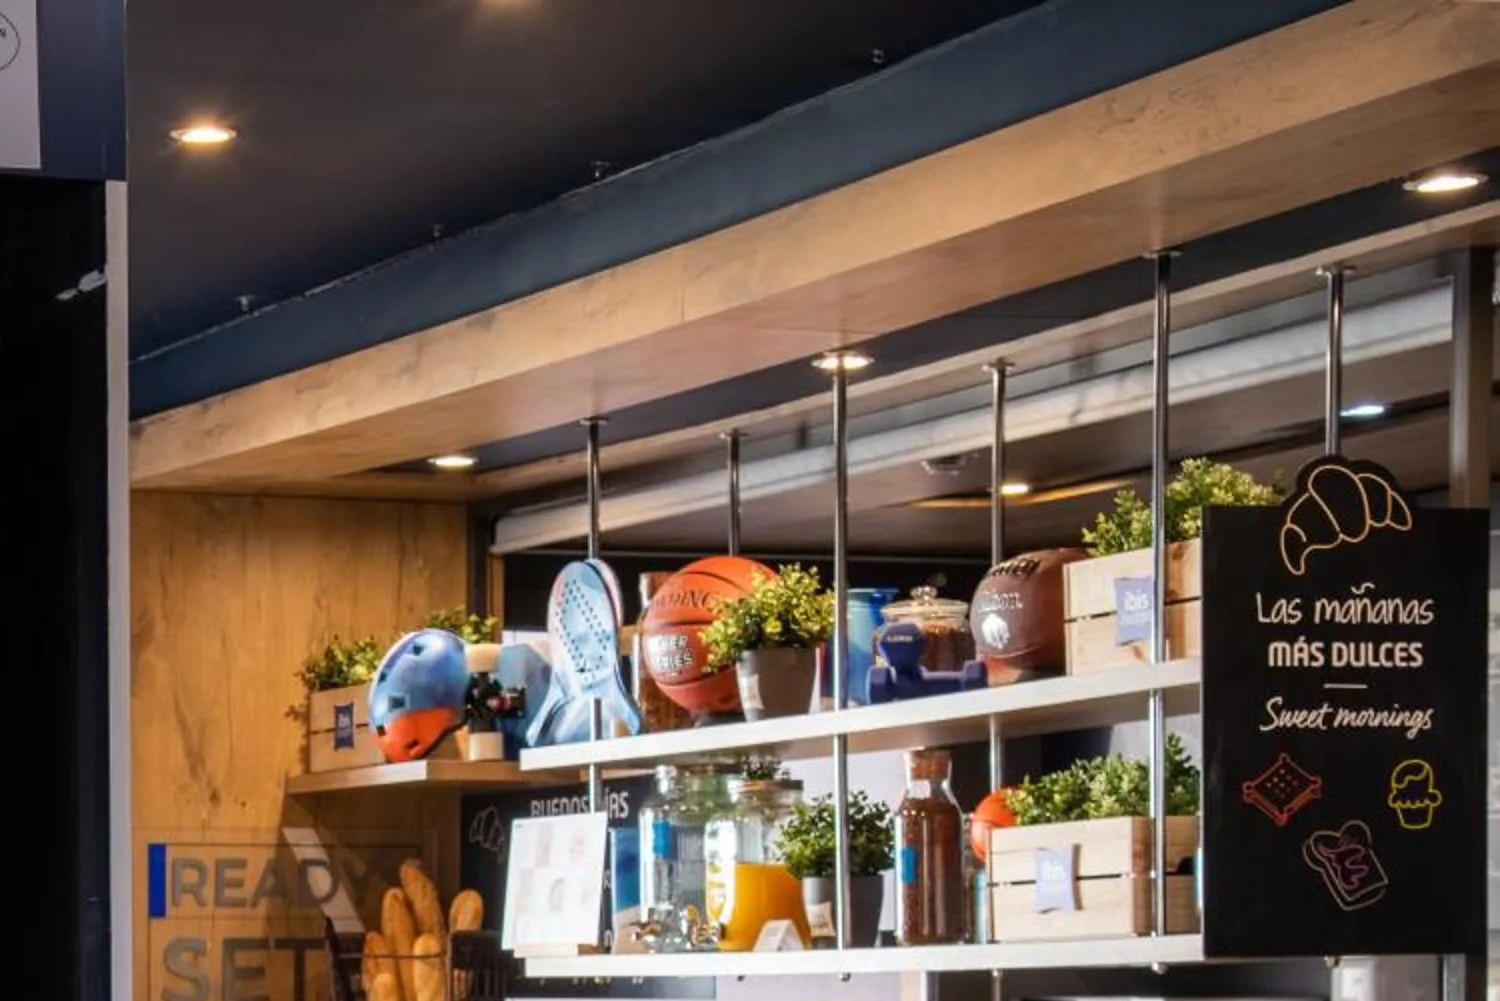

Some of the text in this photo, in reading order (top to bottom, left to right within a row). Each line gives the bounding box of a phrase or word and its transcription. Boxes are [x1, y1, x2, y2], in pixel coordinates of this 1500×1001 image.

[1256, 581, 1435, 626] Las mañanas
[1267, 637, 1424, 668] MÁS DULCES
[1259, 696, 1433, 740] Sweet mornings
